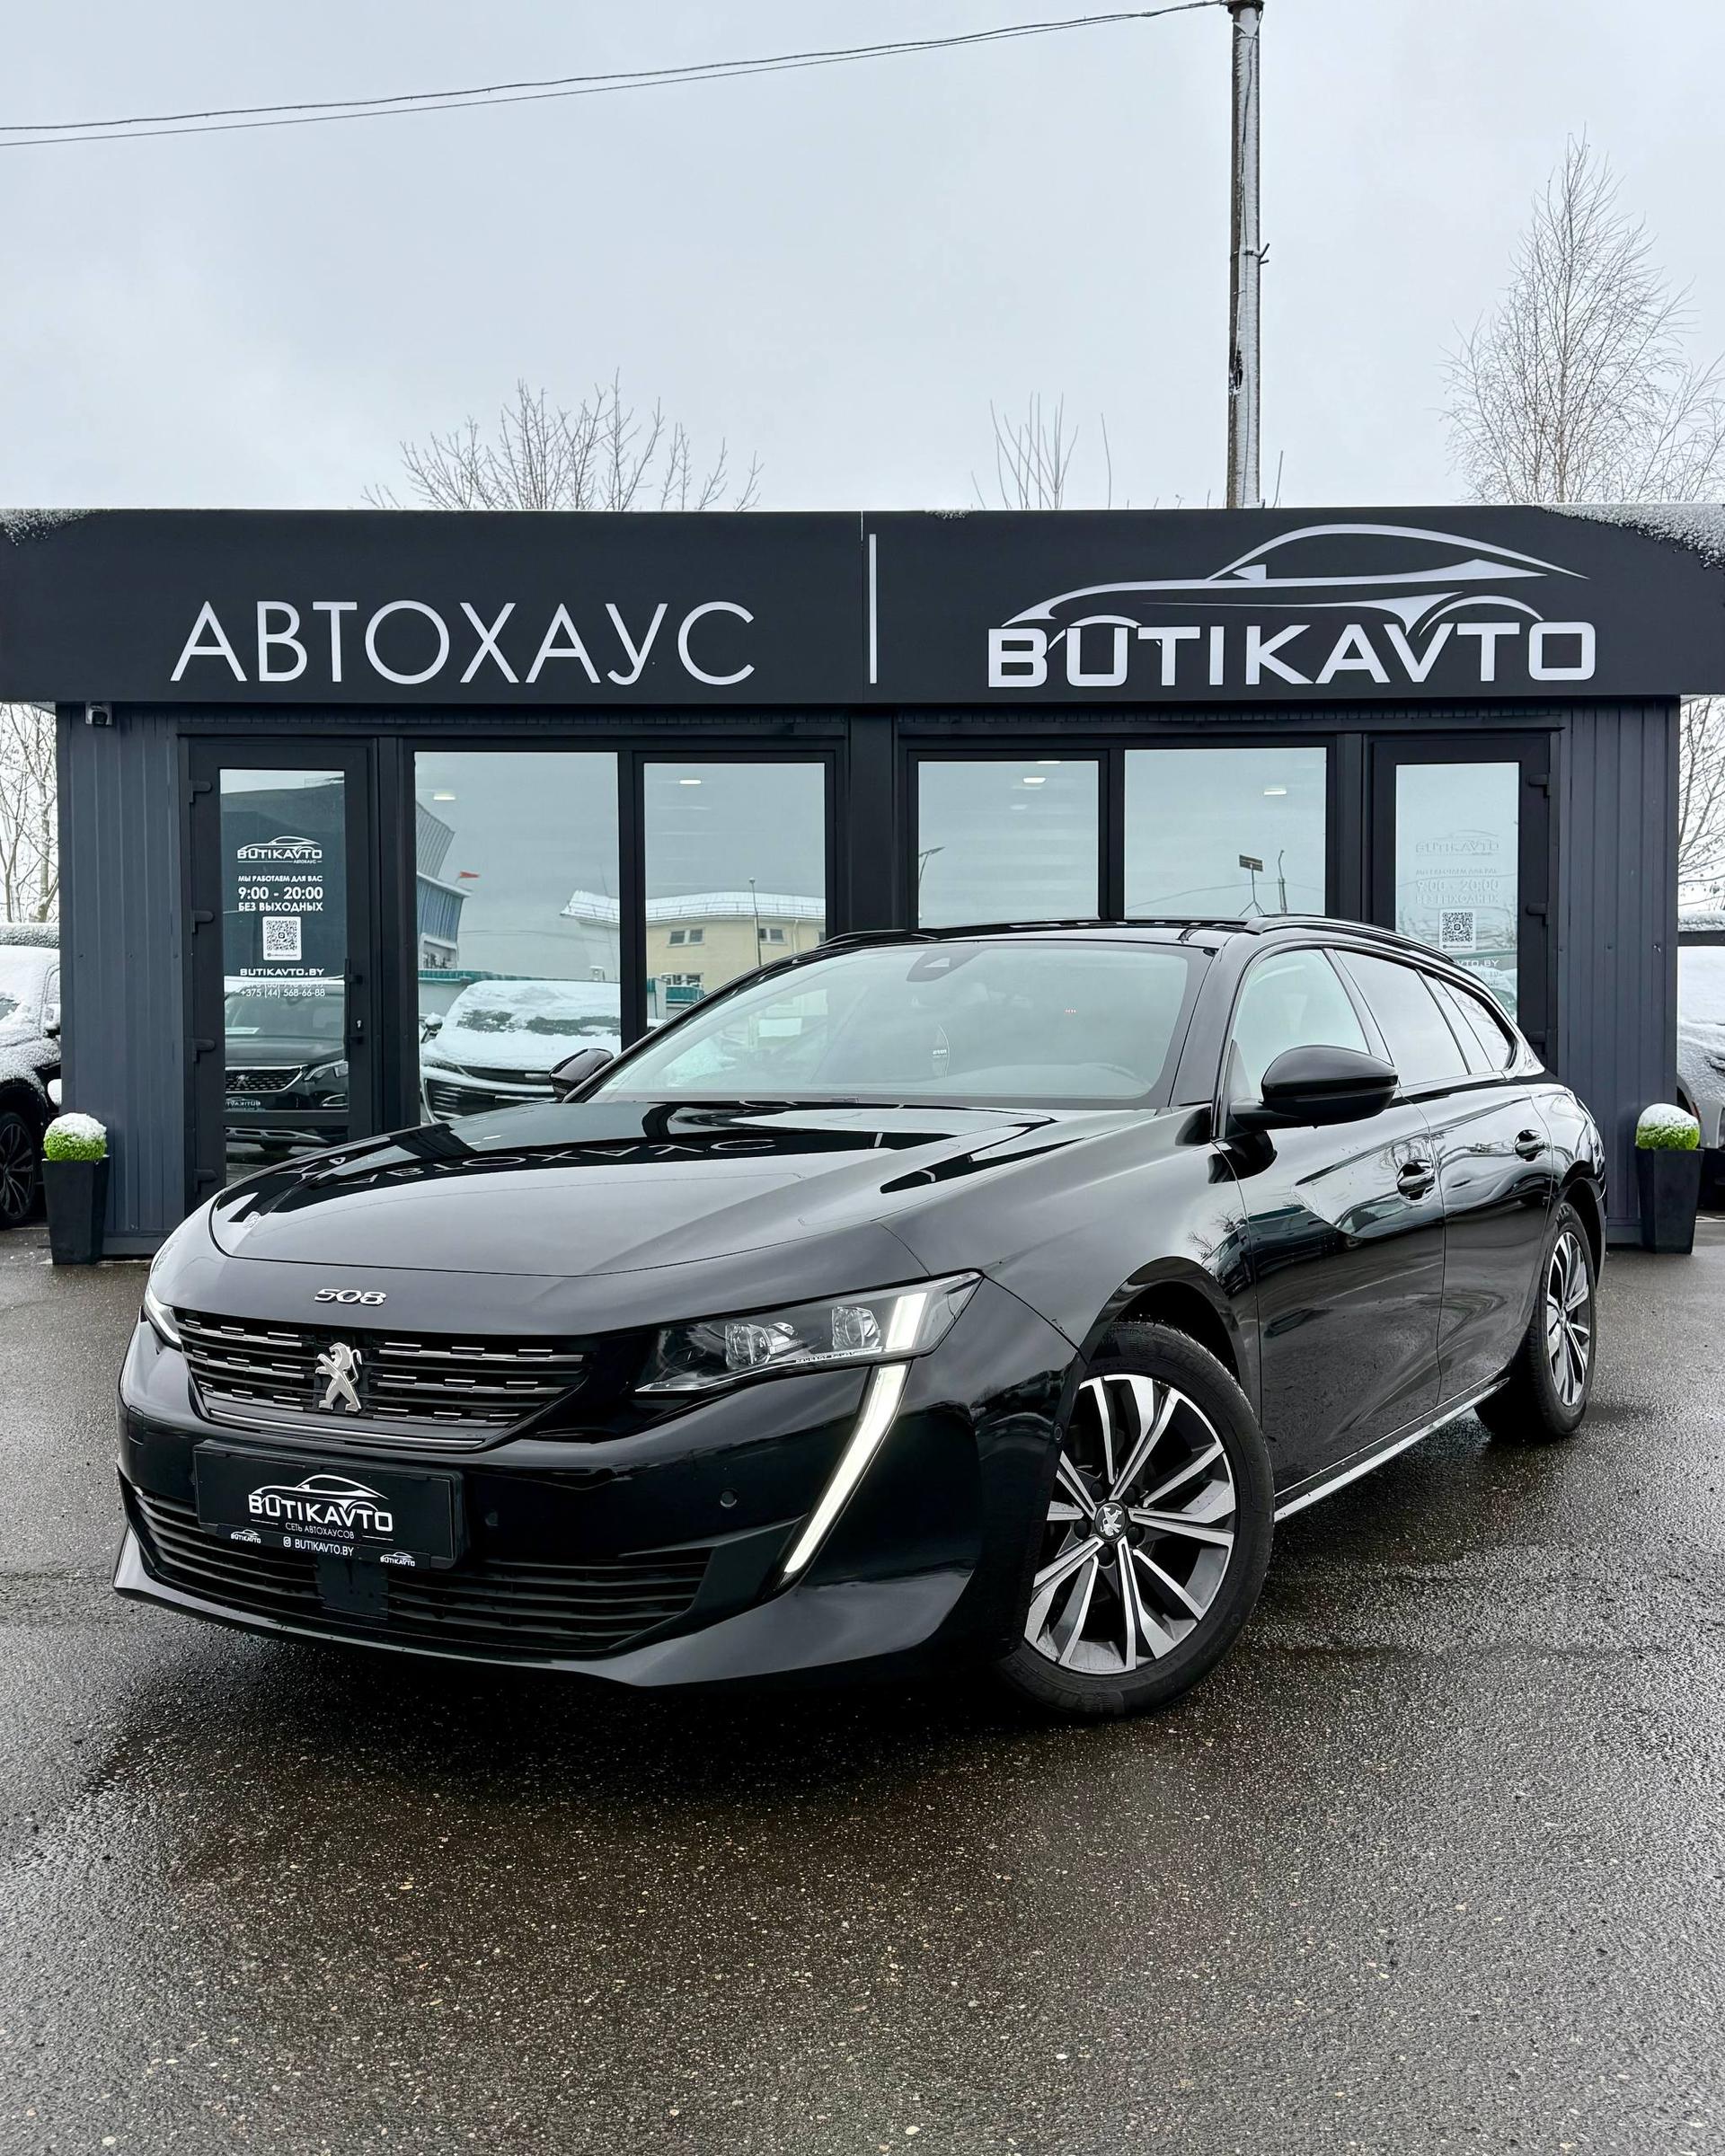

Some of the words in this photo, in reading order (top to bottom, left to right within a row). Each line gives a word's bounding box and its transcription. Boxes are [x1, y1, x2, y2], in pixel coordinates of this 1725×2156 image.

[170, 600, 755, 686] АВТОХАУС
[987, 622, 1596, 688] BUTIKAVTO
[237, 848, 322, 859] BUTIKAVTO
[238, 887, 270, 900] 9:00
[283, 887, 323, 900] 20:00
[238, 902, 257, 912] БЕЗ
[259, 902, 323, 913] ВЫХОДНЫХ
[240, 968, 324, 976] BUTIKAVTO.BY
[241, 989, 262, 997] +375
[264, 988, 280, 999] (44)
[283, 988, 325, 997] 568-66-88
[314, 1288, 387, 1306] 508
[248, 1494, 394, 1533] BUTIKAVTO
[285, 1522, 303, 1533] СЕТЬ
[304, 1524, 355, 1540] АВТОХАУСОВ
[230, 1533, 261, 1544] BUTIKAVTO
[295, 1539, 354, 1557] BUTIKAVTO.BY
[380, 1555, 416, 1567] BUTIKAVTO
